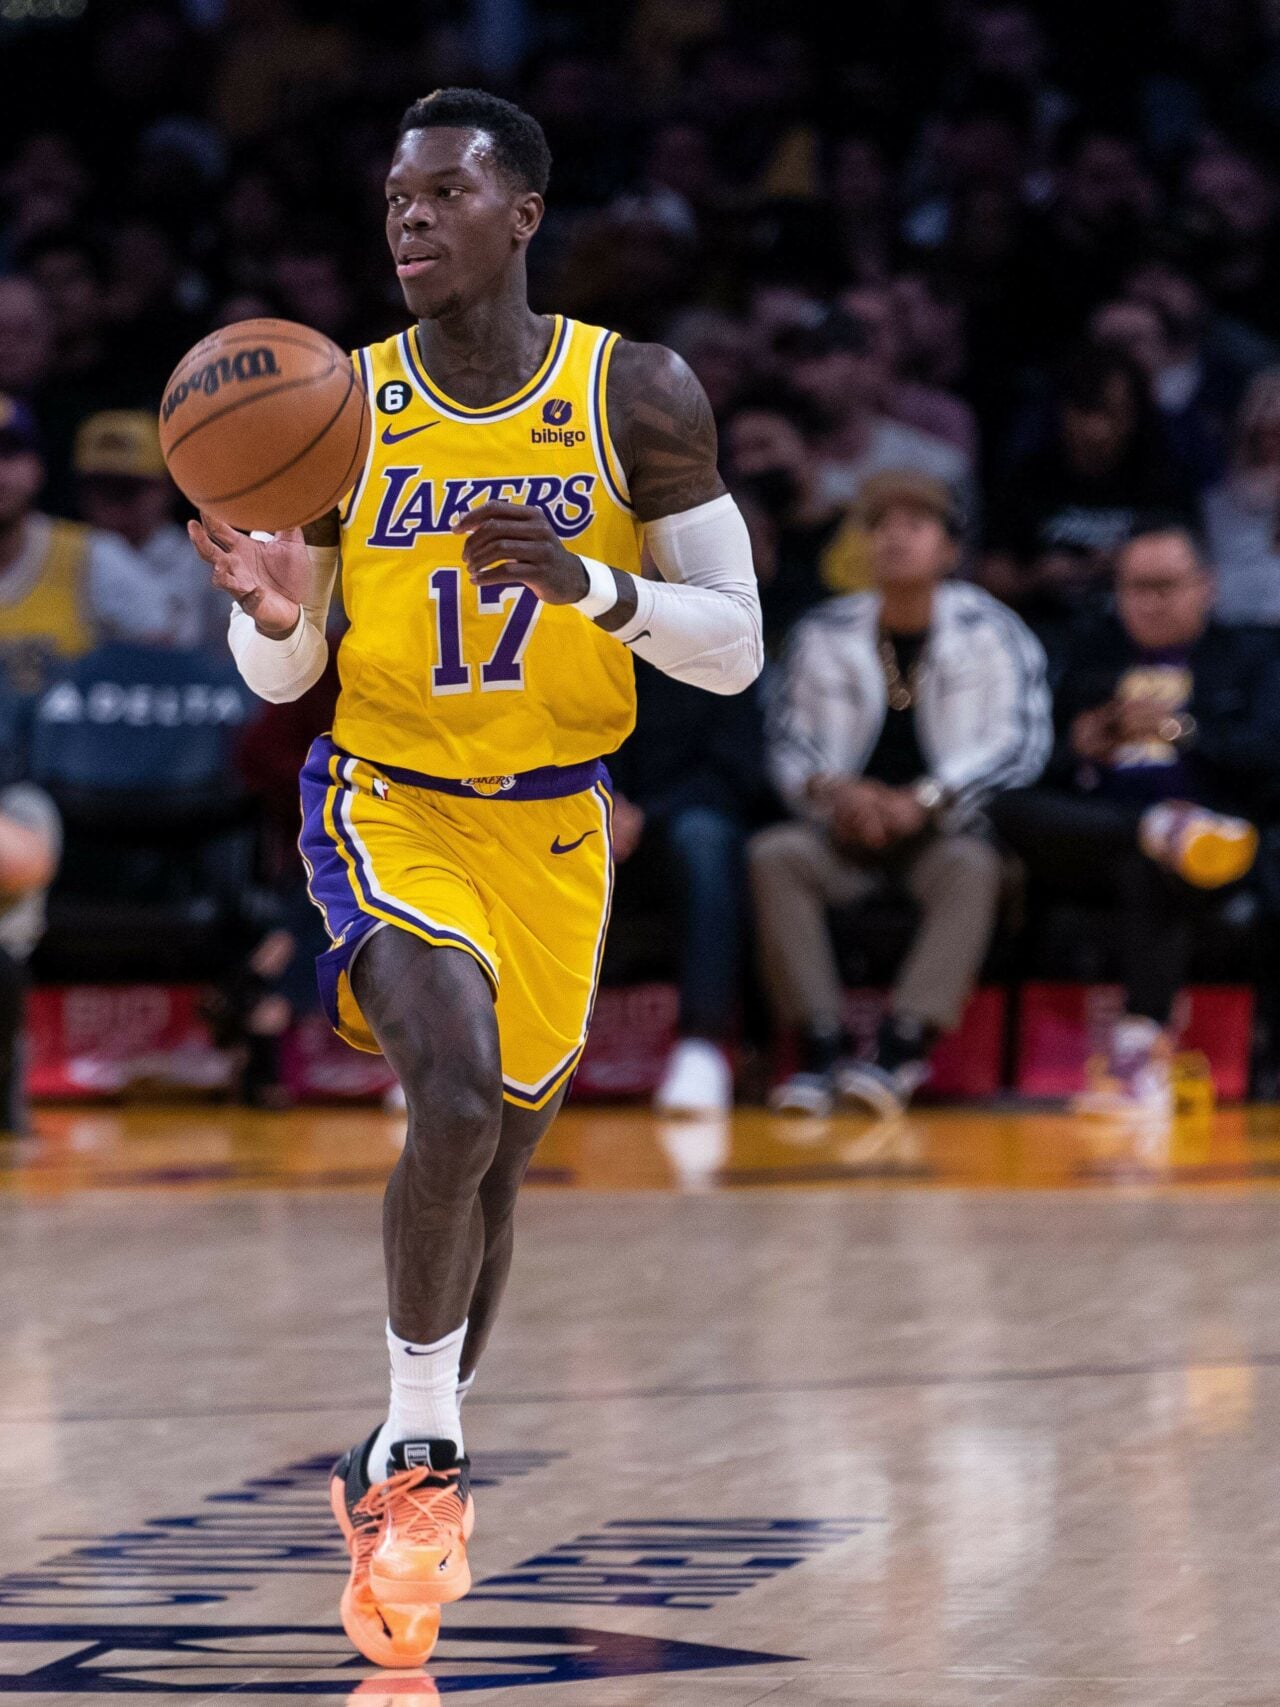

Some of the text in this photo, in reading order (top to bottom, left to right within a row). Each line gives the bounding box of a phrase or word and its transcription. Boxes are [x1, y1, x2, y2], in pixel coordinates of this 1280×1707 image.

[384, 384, 404, 411] 6
[531, 428, 586, 447] bibigo
[428, 566, 544, 697] 17
